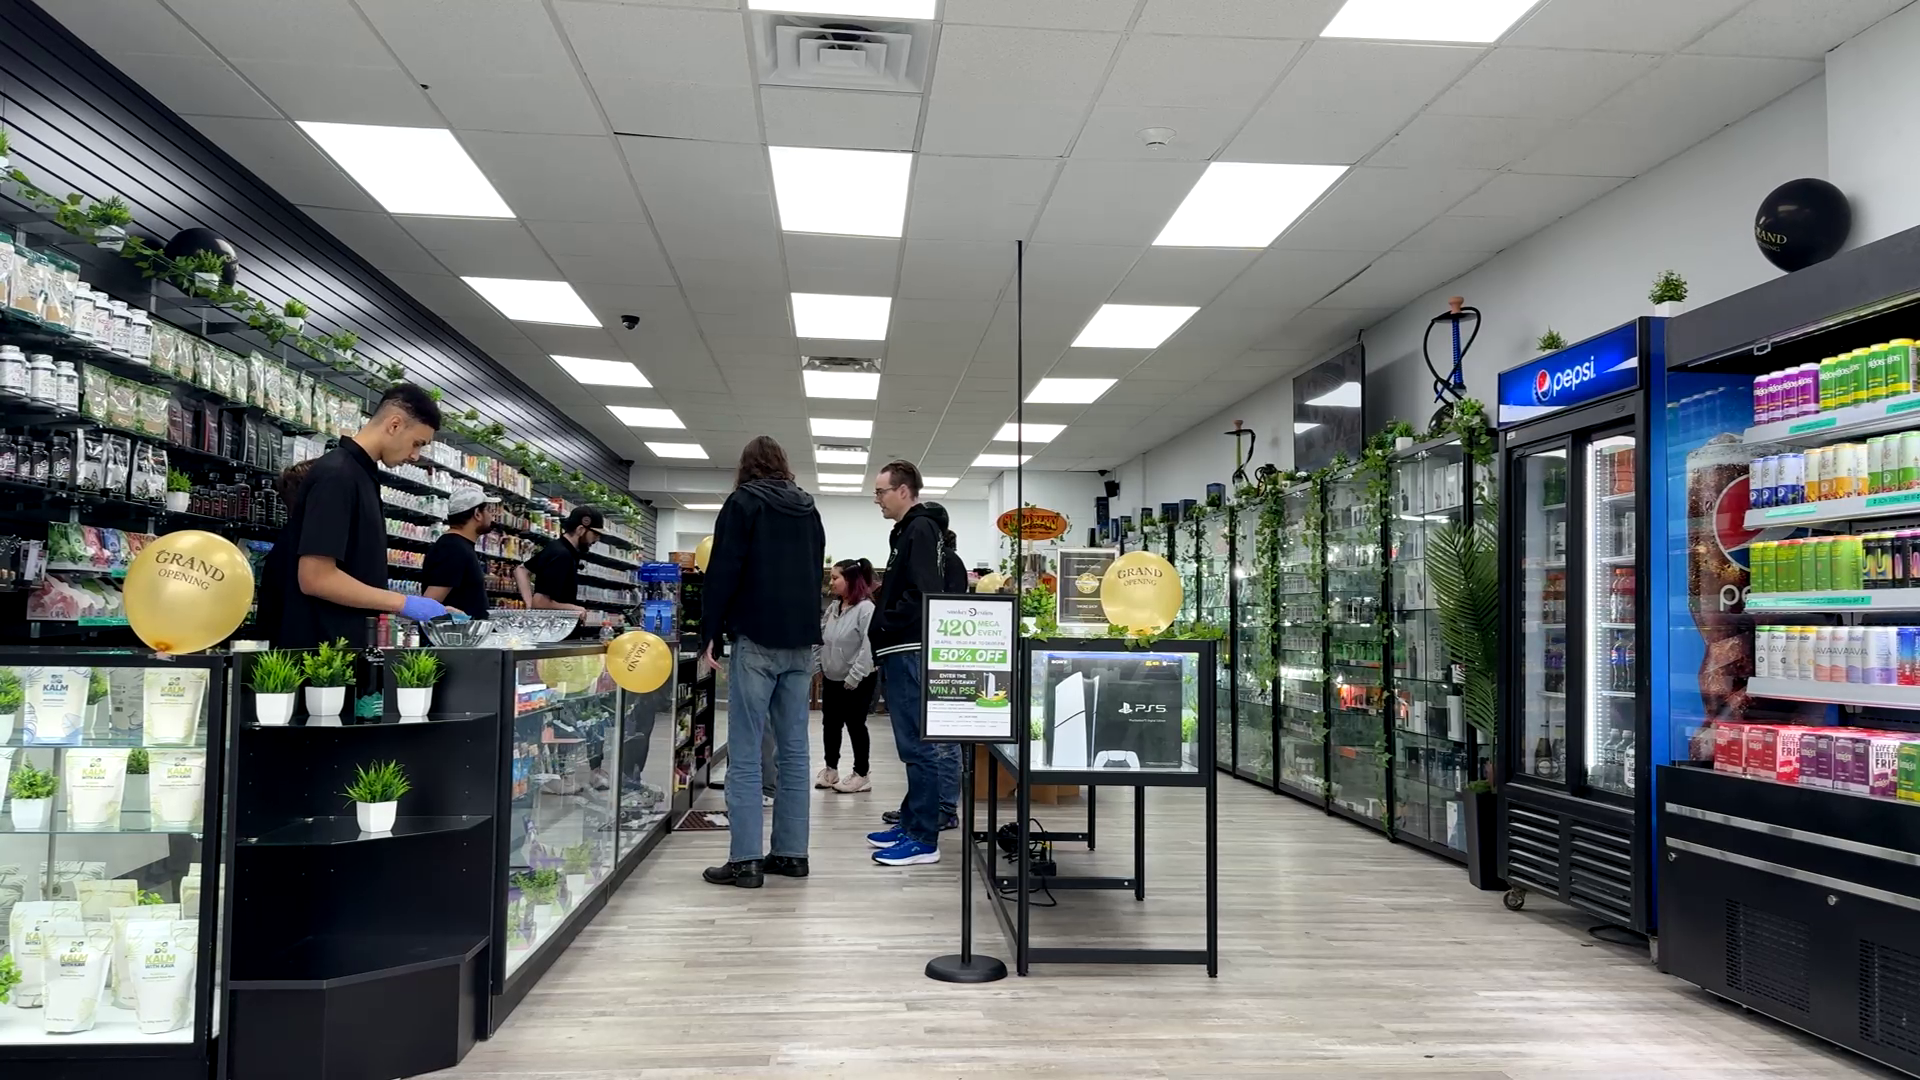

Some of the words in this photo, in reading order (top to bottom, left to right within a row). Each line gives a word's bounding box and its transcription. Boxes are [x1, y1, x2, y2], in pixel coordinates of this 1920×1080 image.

[1755, 226, 1787, 244] RAND
[1553, 356, 1594, 397] pepsi
[155, 549, 226, 582] GRAND
[1117, 567, 1163, 579] GRAND
[158, 568, 210, 591] OPENING
[1123, 579, 1157, 587] OPENING
[936, 619, 977, 637] 420
[627, 641, 651, 672] GRAND
[939, 648, 972, 661] 50%
[975, 650, 1004, 662] OFF
[160, 686, 186, 694] KALM
[928, 686, 948, 694] WIN
[959, 687, 976, 695] PS5
[1135, 704, 1167, 713] PS5
[1782, 740, 1800, 748] BETTE
[81, 767, 106, 776] KALM
[167, 767, 192, 775] KALM
[25, 932, 40, 941] KA
[59, 954, 88, 963] KALM
[145, 954, 176, 964] KALM
